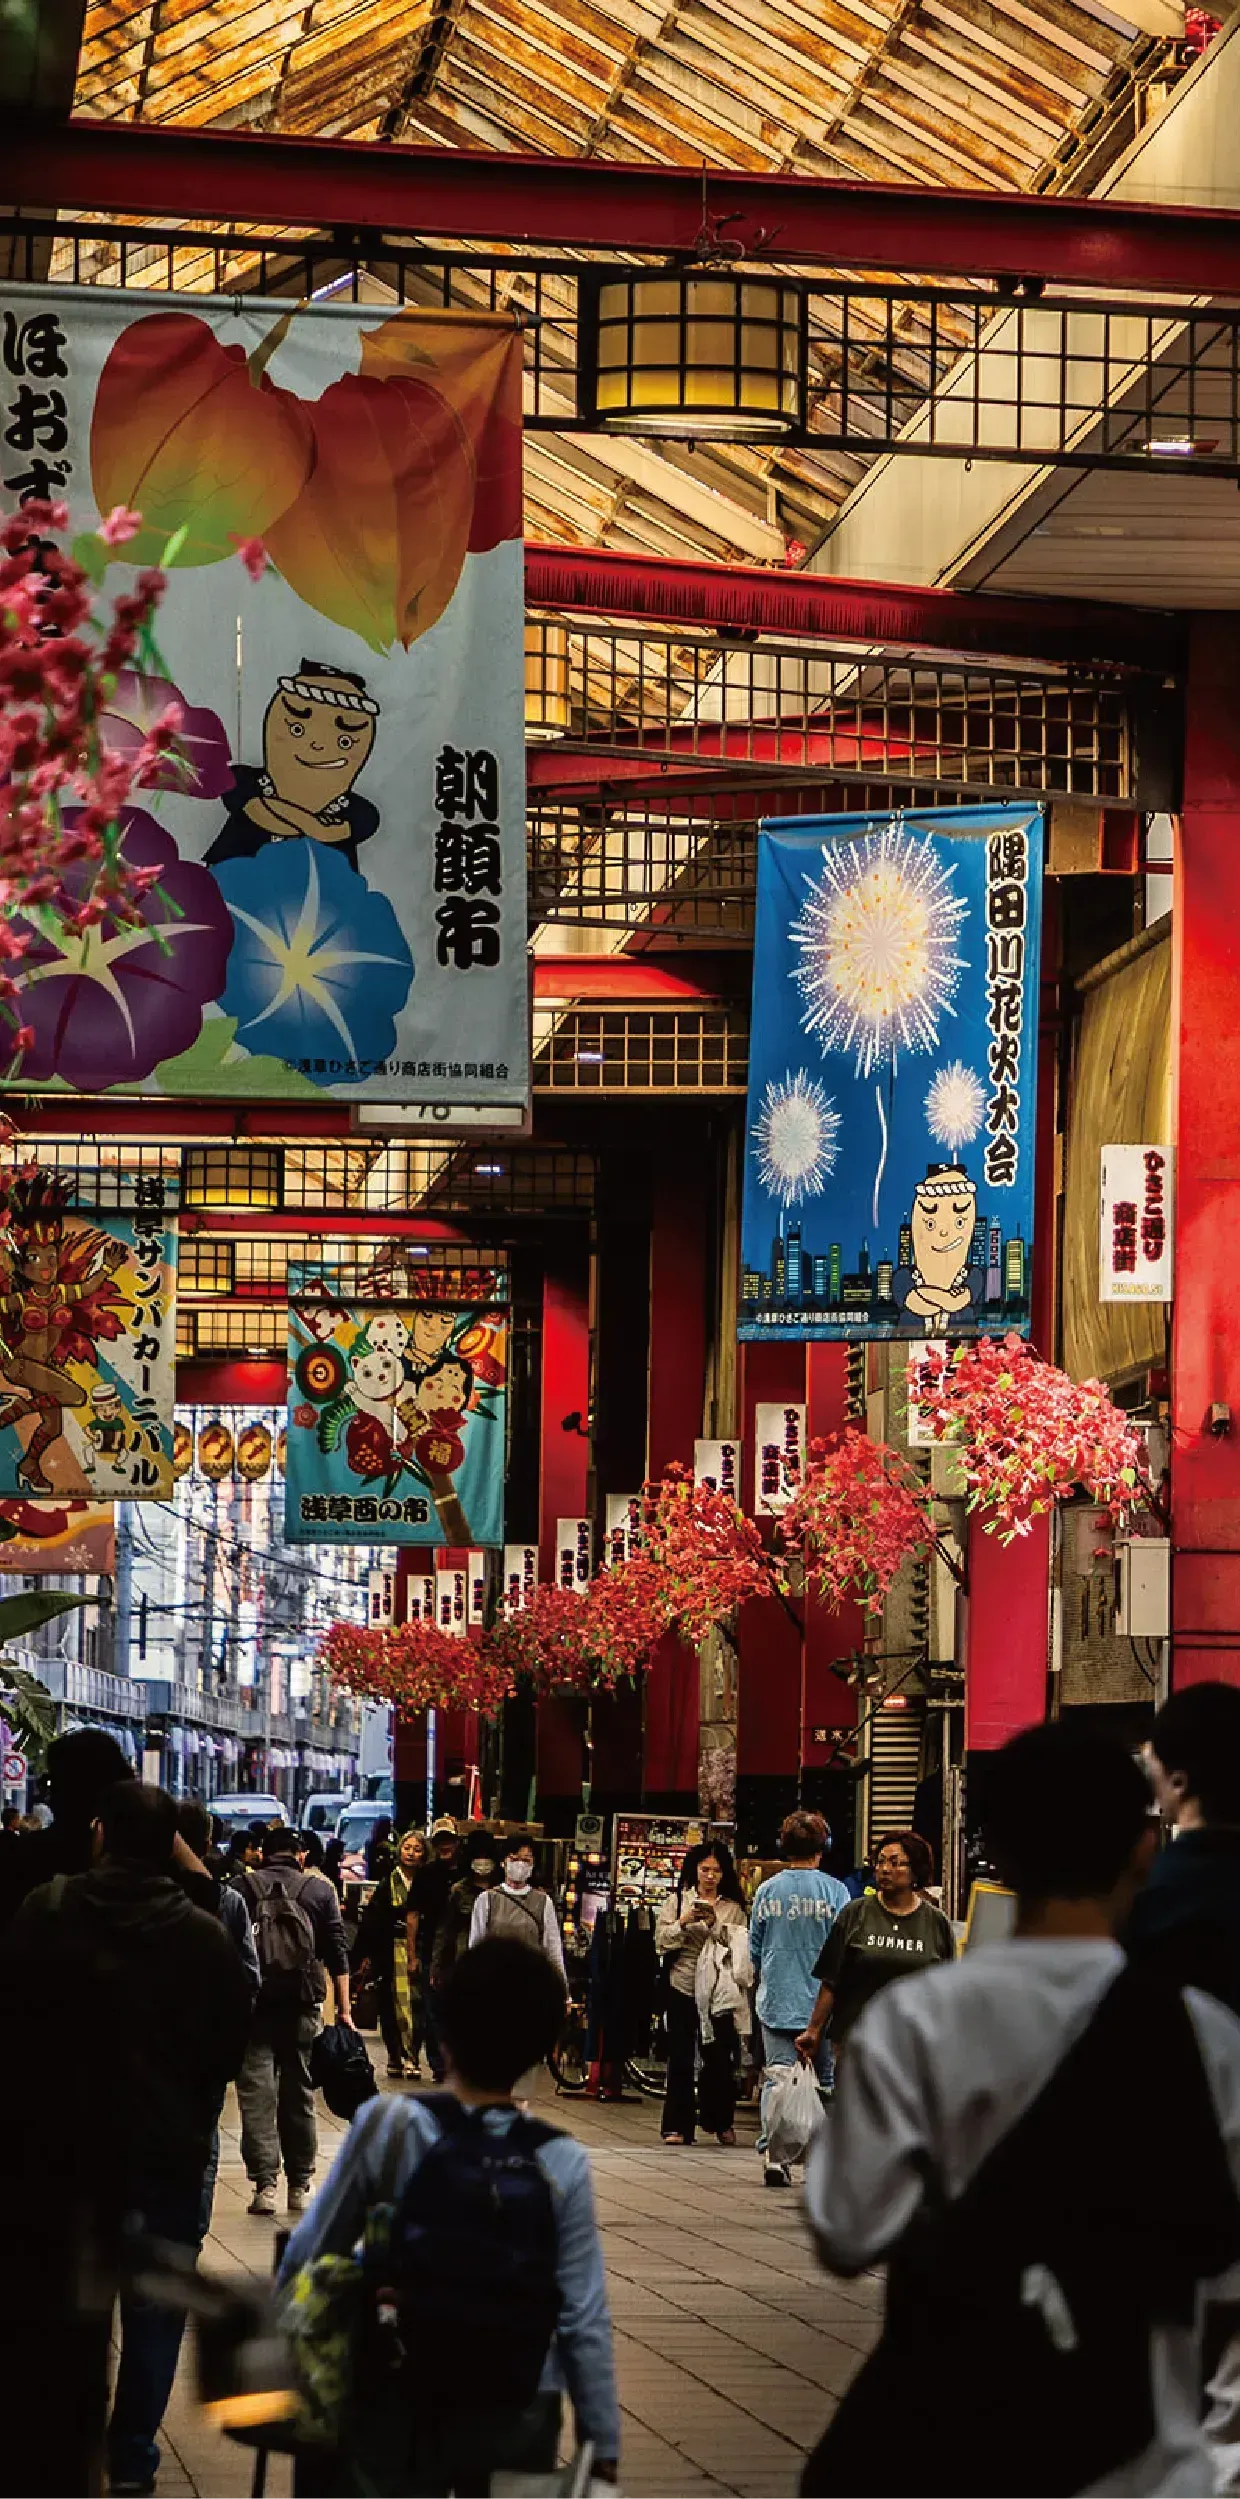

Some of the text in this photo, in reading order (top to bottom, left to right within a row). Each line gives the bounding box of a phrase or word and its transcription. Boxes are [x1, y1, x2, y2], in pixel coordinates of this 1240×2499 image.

[3, 311, 72, 640] ほおず
[435, 744, 502, 970] 朝顔市
[987, 832, 1027, 1184] 隅田川花火大会
[301, 1495, 429, 1523] 浅草酉の市
[867, 1935, 924, 1951] SUMMER
